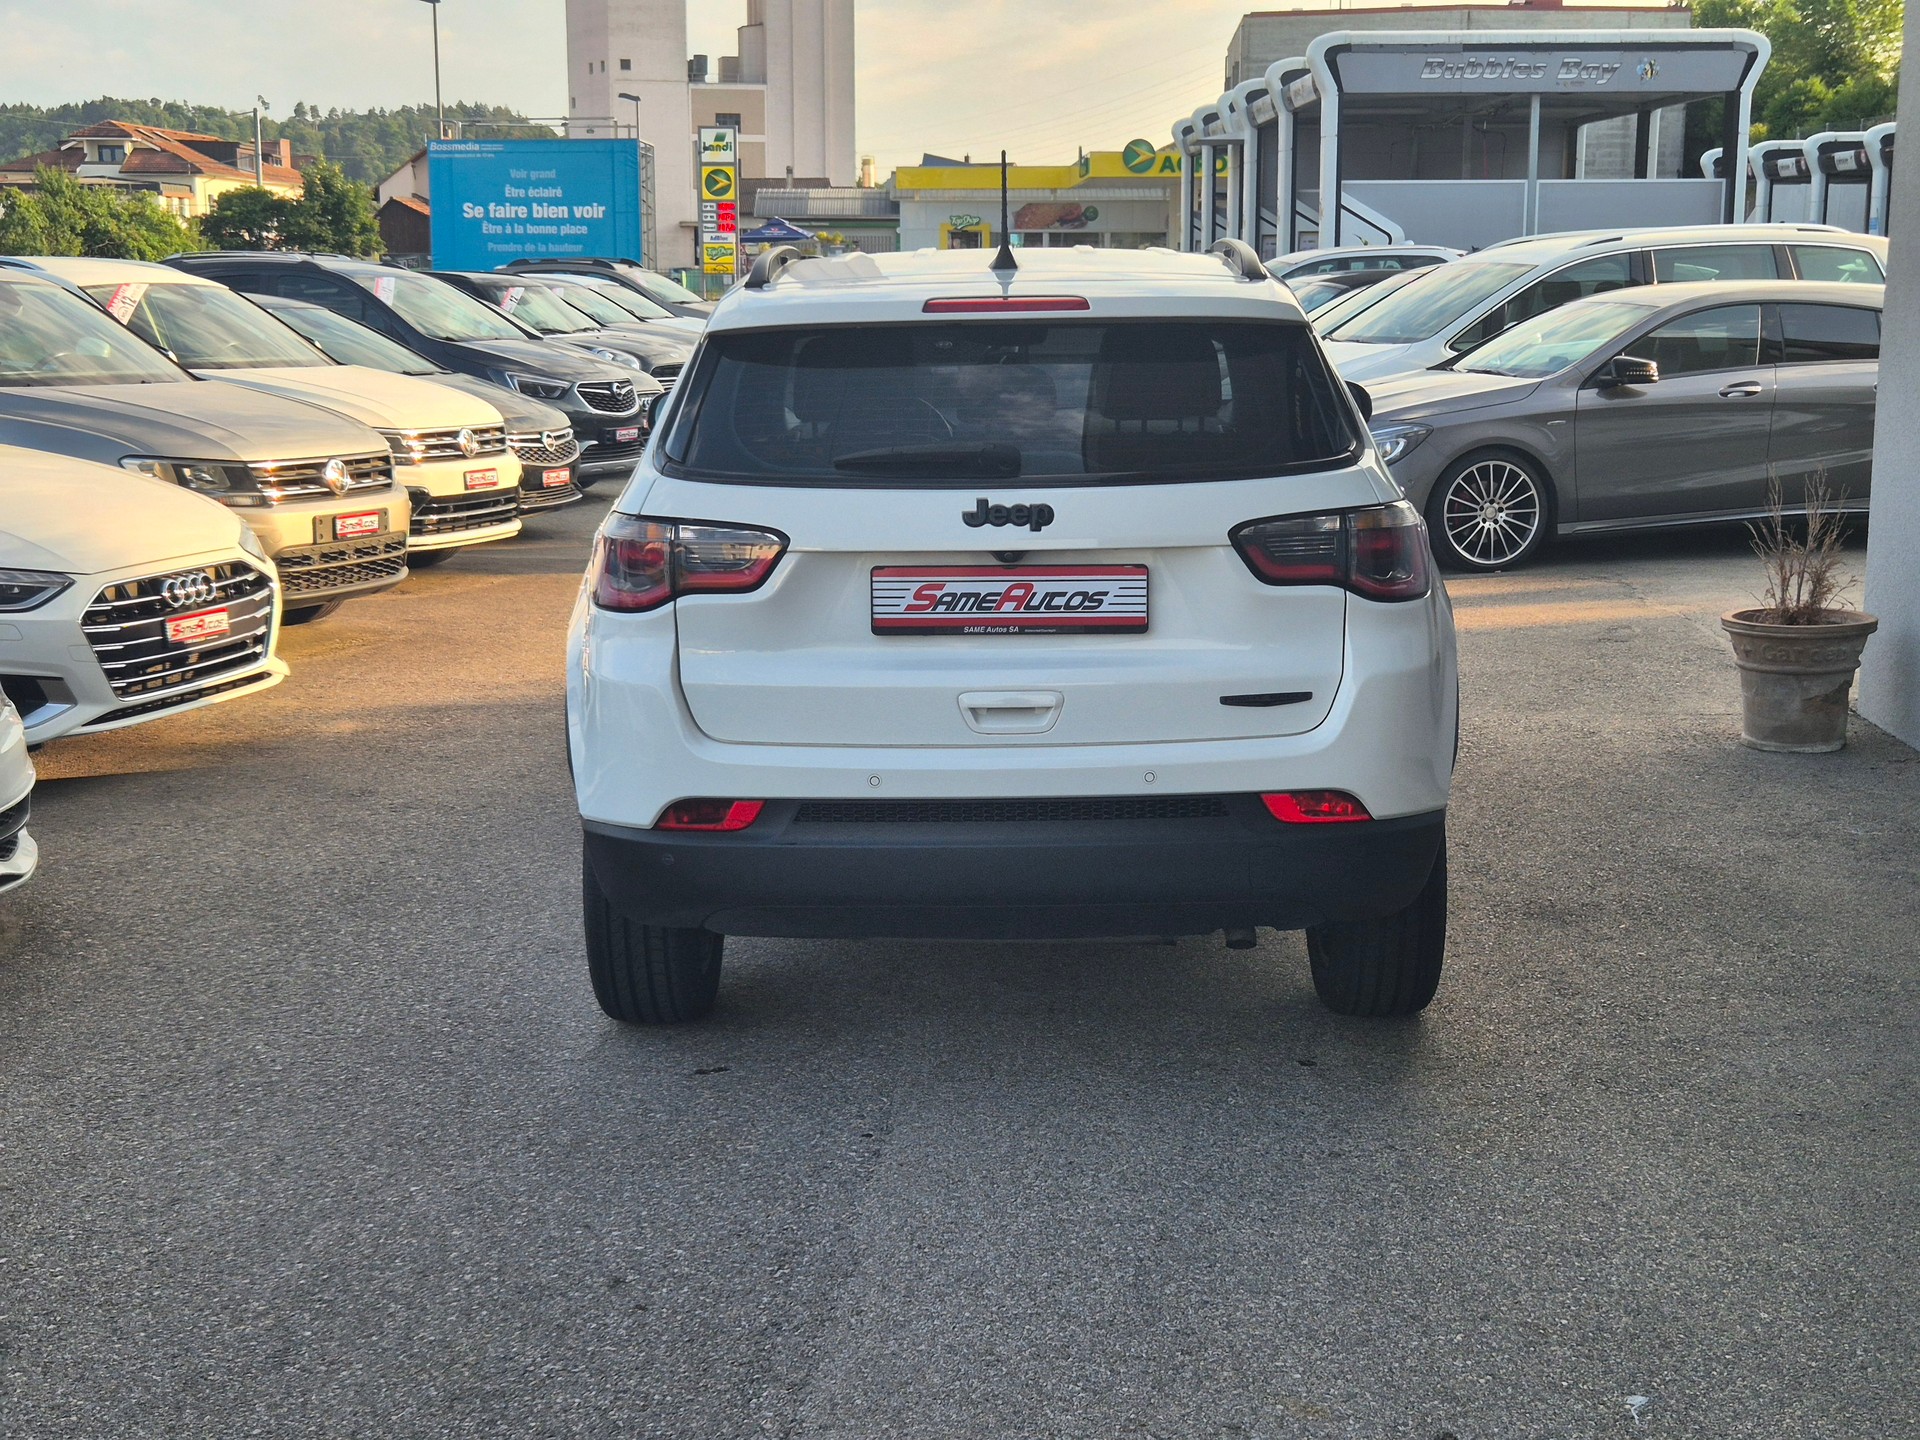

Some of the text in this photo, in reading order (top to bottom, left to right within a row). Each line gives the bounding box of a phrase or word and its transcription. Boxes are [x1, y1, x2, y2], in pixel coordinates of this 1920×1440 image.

[1420, 57, 1623, 85] Bubbles Bay
[430, 141, 480, 151] Bossmedia
[509, 169, 556, 180] Voir grand
[505, 184, 563, 197] Être éclairé
[463, 202, 606, 218] Se faire bien voir
[482, 221, 588, 236] Être à la bonne place
[488, 242, 522, 252] Prendre
[524, 242, 535, 252] de
[538, 242, 546, 252] la
[961, 497, 1055, 532] Jeep
